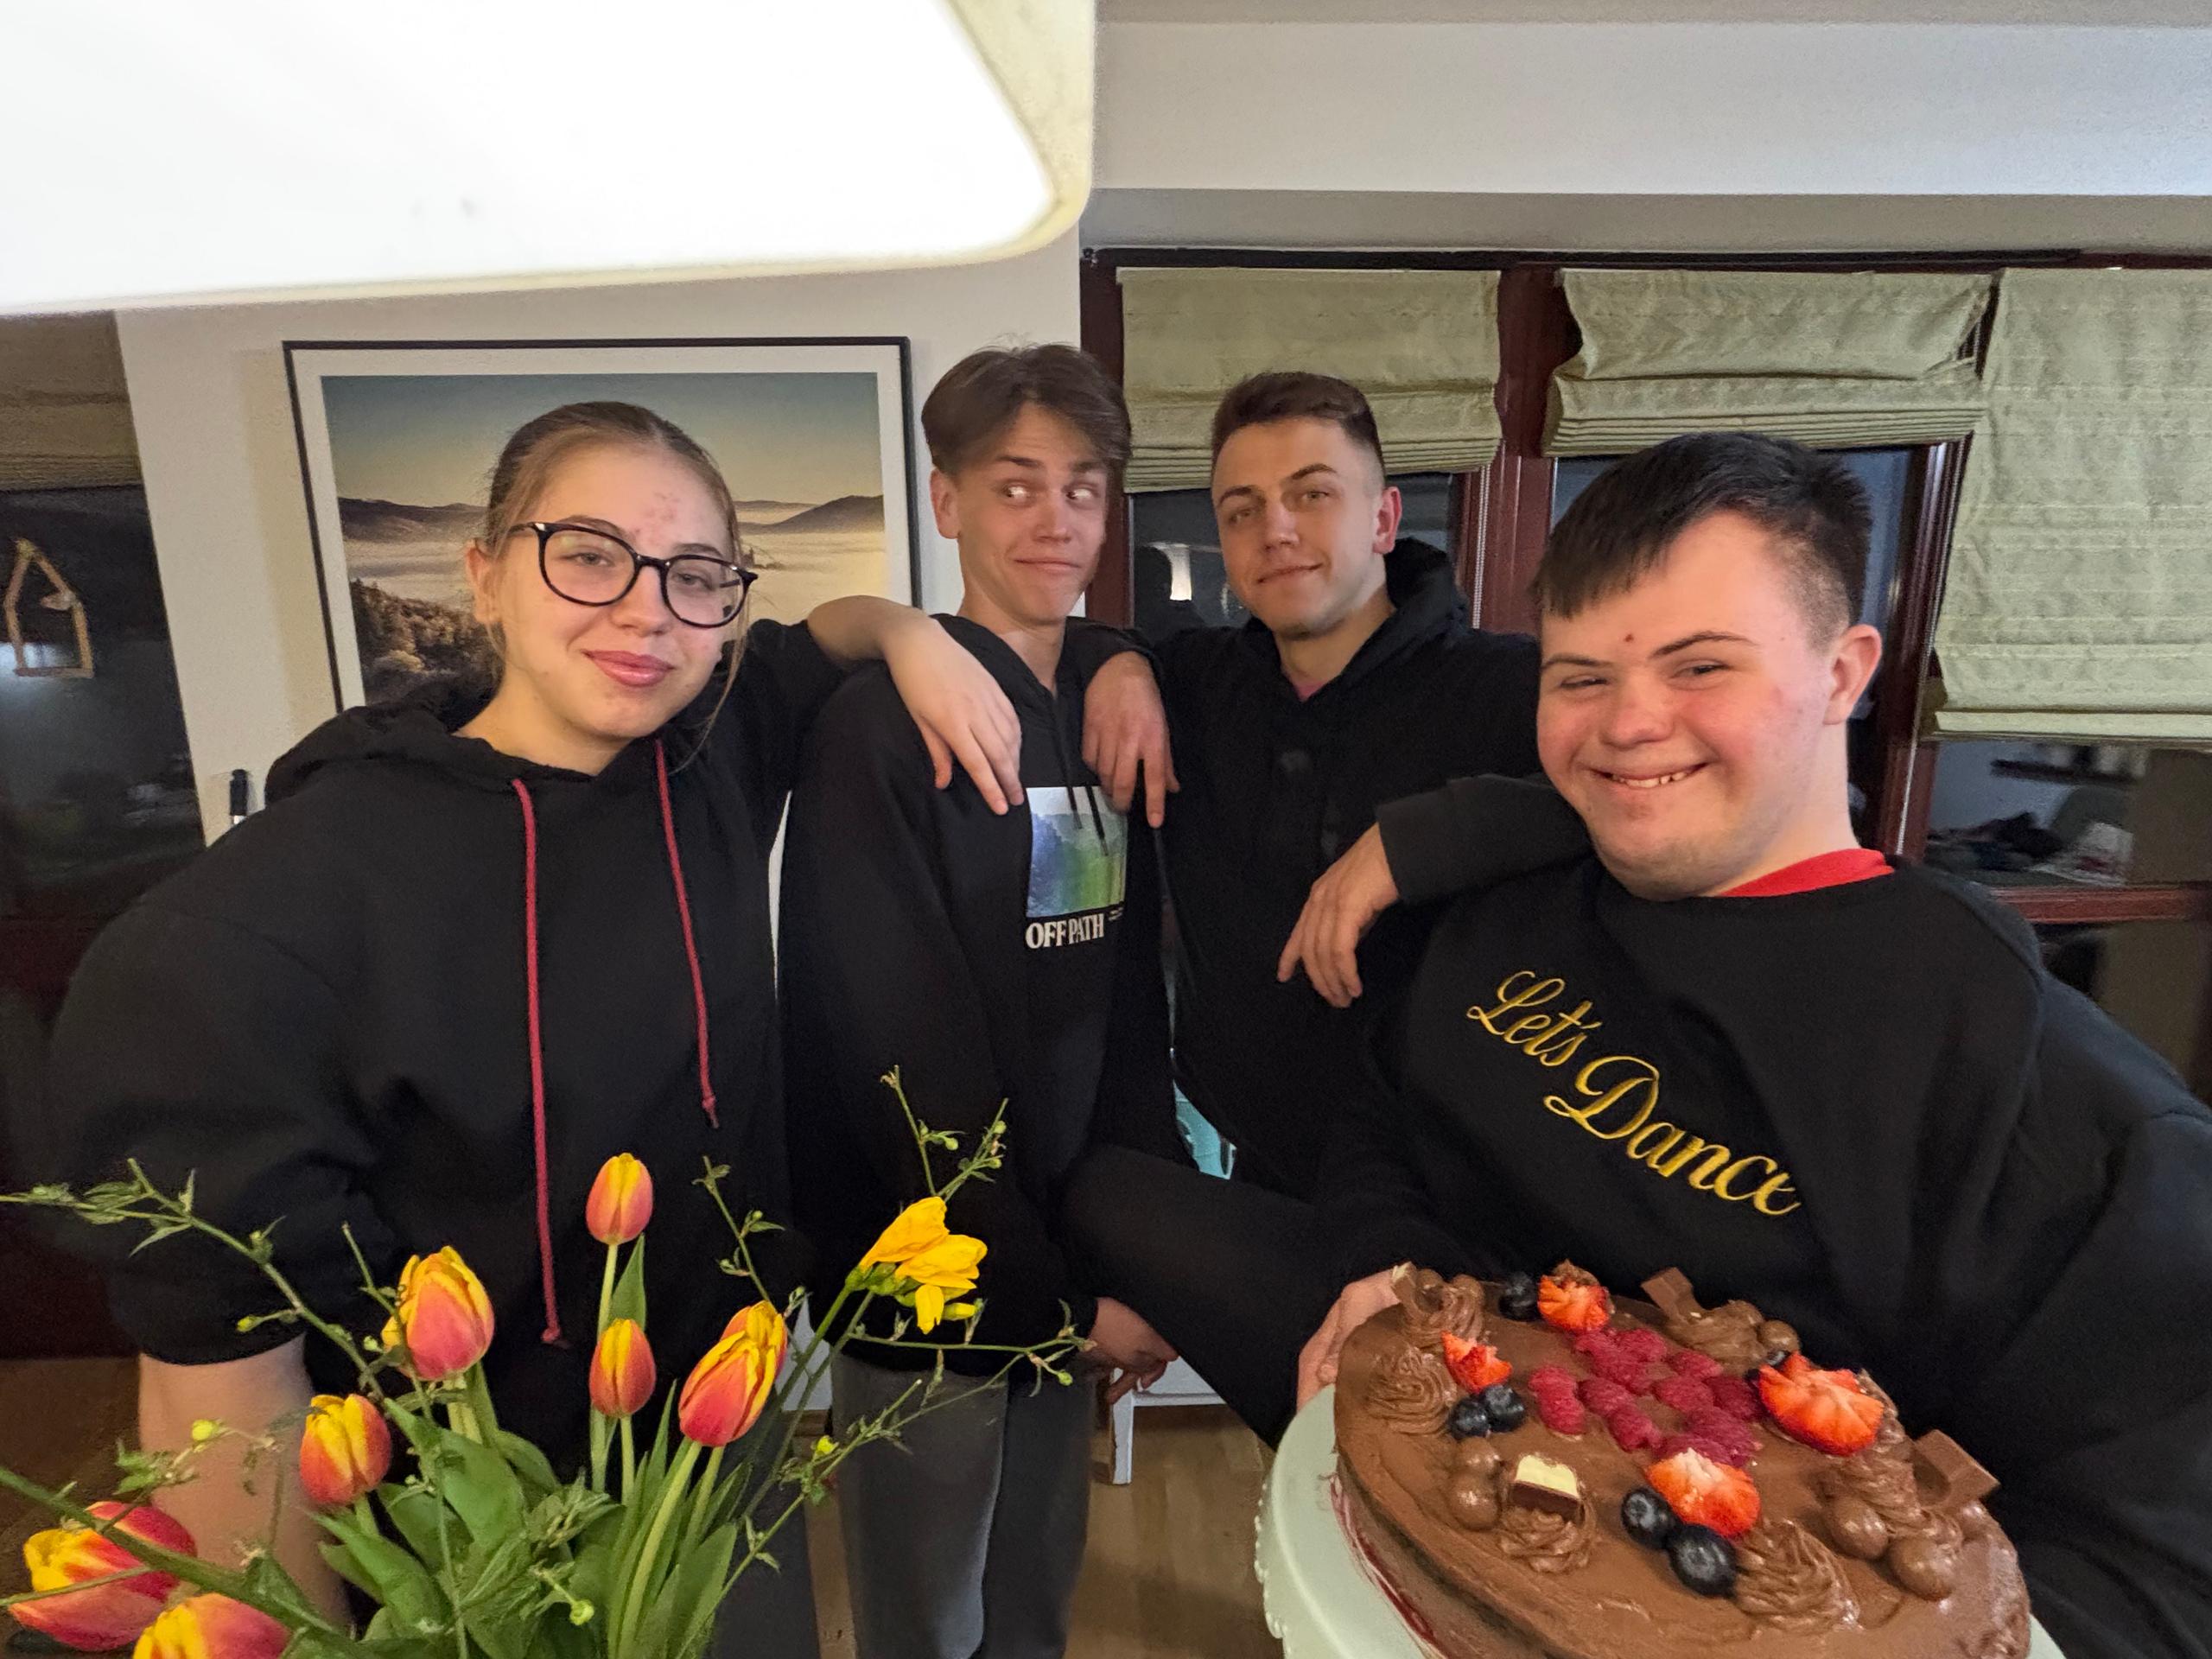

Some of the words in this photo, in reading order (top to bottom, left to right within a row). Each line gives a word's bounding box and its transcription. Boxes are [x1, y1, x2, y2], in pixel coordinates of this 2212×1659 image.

[1025, 920, 1067, 949] OFF
[1068, 913, 1105, 944] PATH
[1466, 970, 1602, 1066] Let's
[1543, 1055, 1802, 1216] Dance
